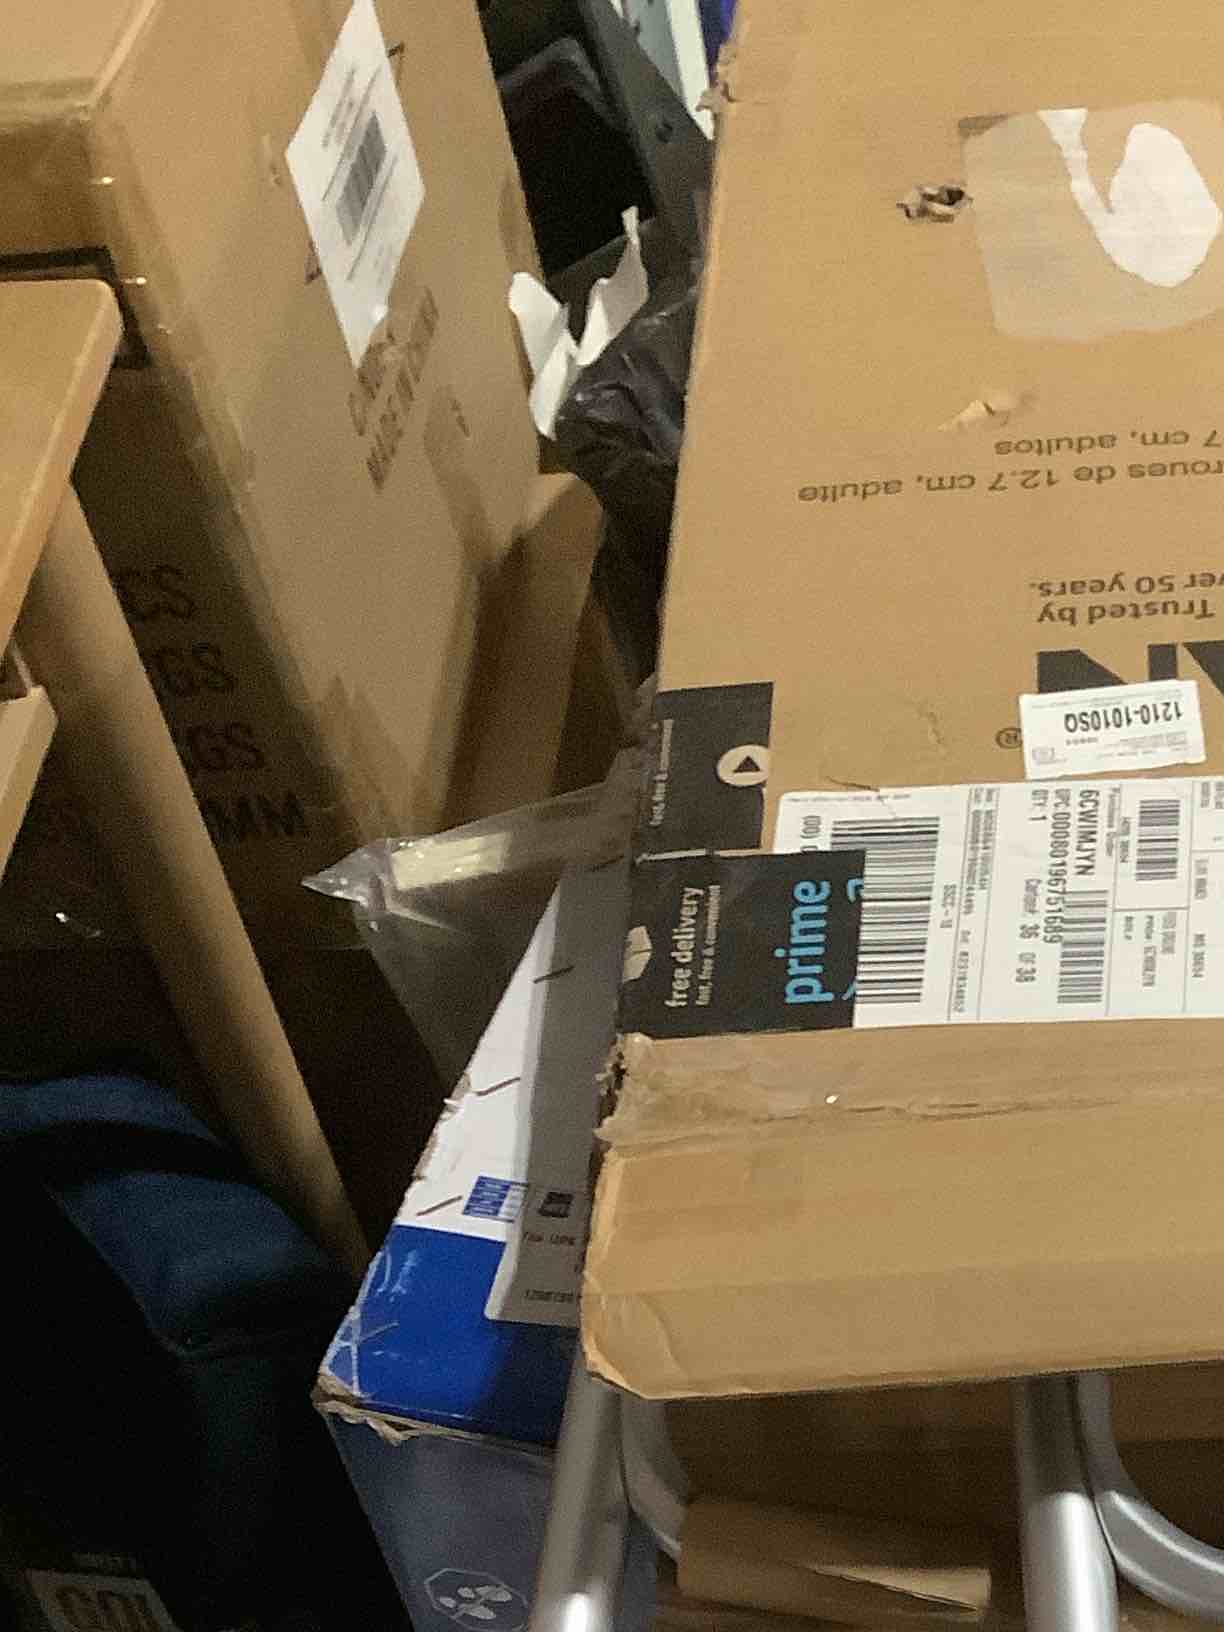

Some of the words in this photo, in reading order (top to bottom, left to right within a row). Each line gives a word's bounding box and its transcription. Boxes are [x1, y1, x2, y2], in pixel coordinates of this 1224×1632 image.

[994, 433, 1117, 457] adultos
[1129, 430, 1190, 449] cm,
[987, 468, 1060, 492] 12.7
[1072, 464, 1116, 485] de
[1127, 459, 1224, 480] roues
[796, 479, 903, 506] adulte
[915, 474, 976, 495] cm,
[1028, 572, 1125, 600] years.
[1134, 574, 1175, 596] 50
[1036, 602, 1077, 627] by
[1088, 599, 1214, 625] Trusted
[1064, 701, 1183, 734] 1210-1010SQ
[1073, 789, 1100, 877] 6CWIMJYN
[670, 886, 705, 963] delivery
[774, 880, 835, 1003] prime
[664, 967, 693, 1008] free
